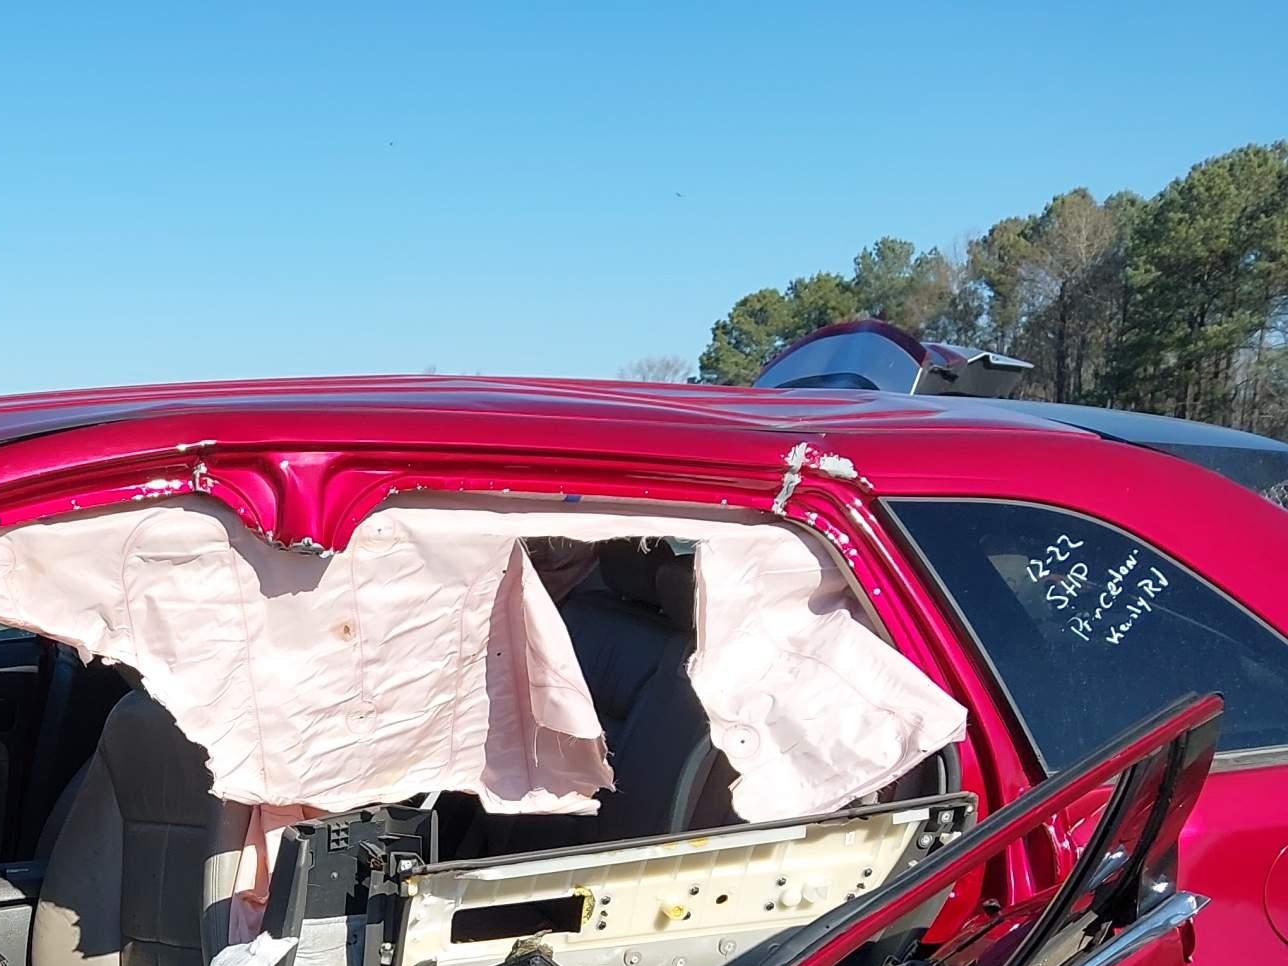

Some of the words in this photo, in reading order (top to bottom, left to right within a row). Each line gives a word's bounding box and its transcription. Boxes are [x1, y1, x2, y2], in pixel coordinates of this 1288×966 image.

[1027, 534, 1084, 582] 12-22
[1046, 562, 1088, 610] SHP
[1138, 566, 1169, 599] Rd
